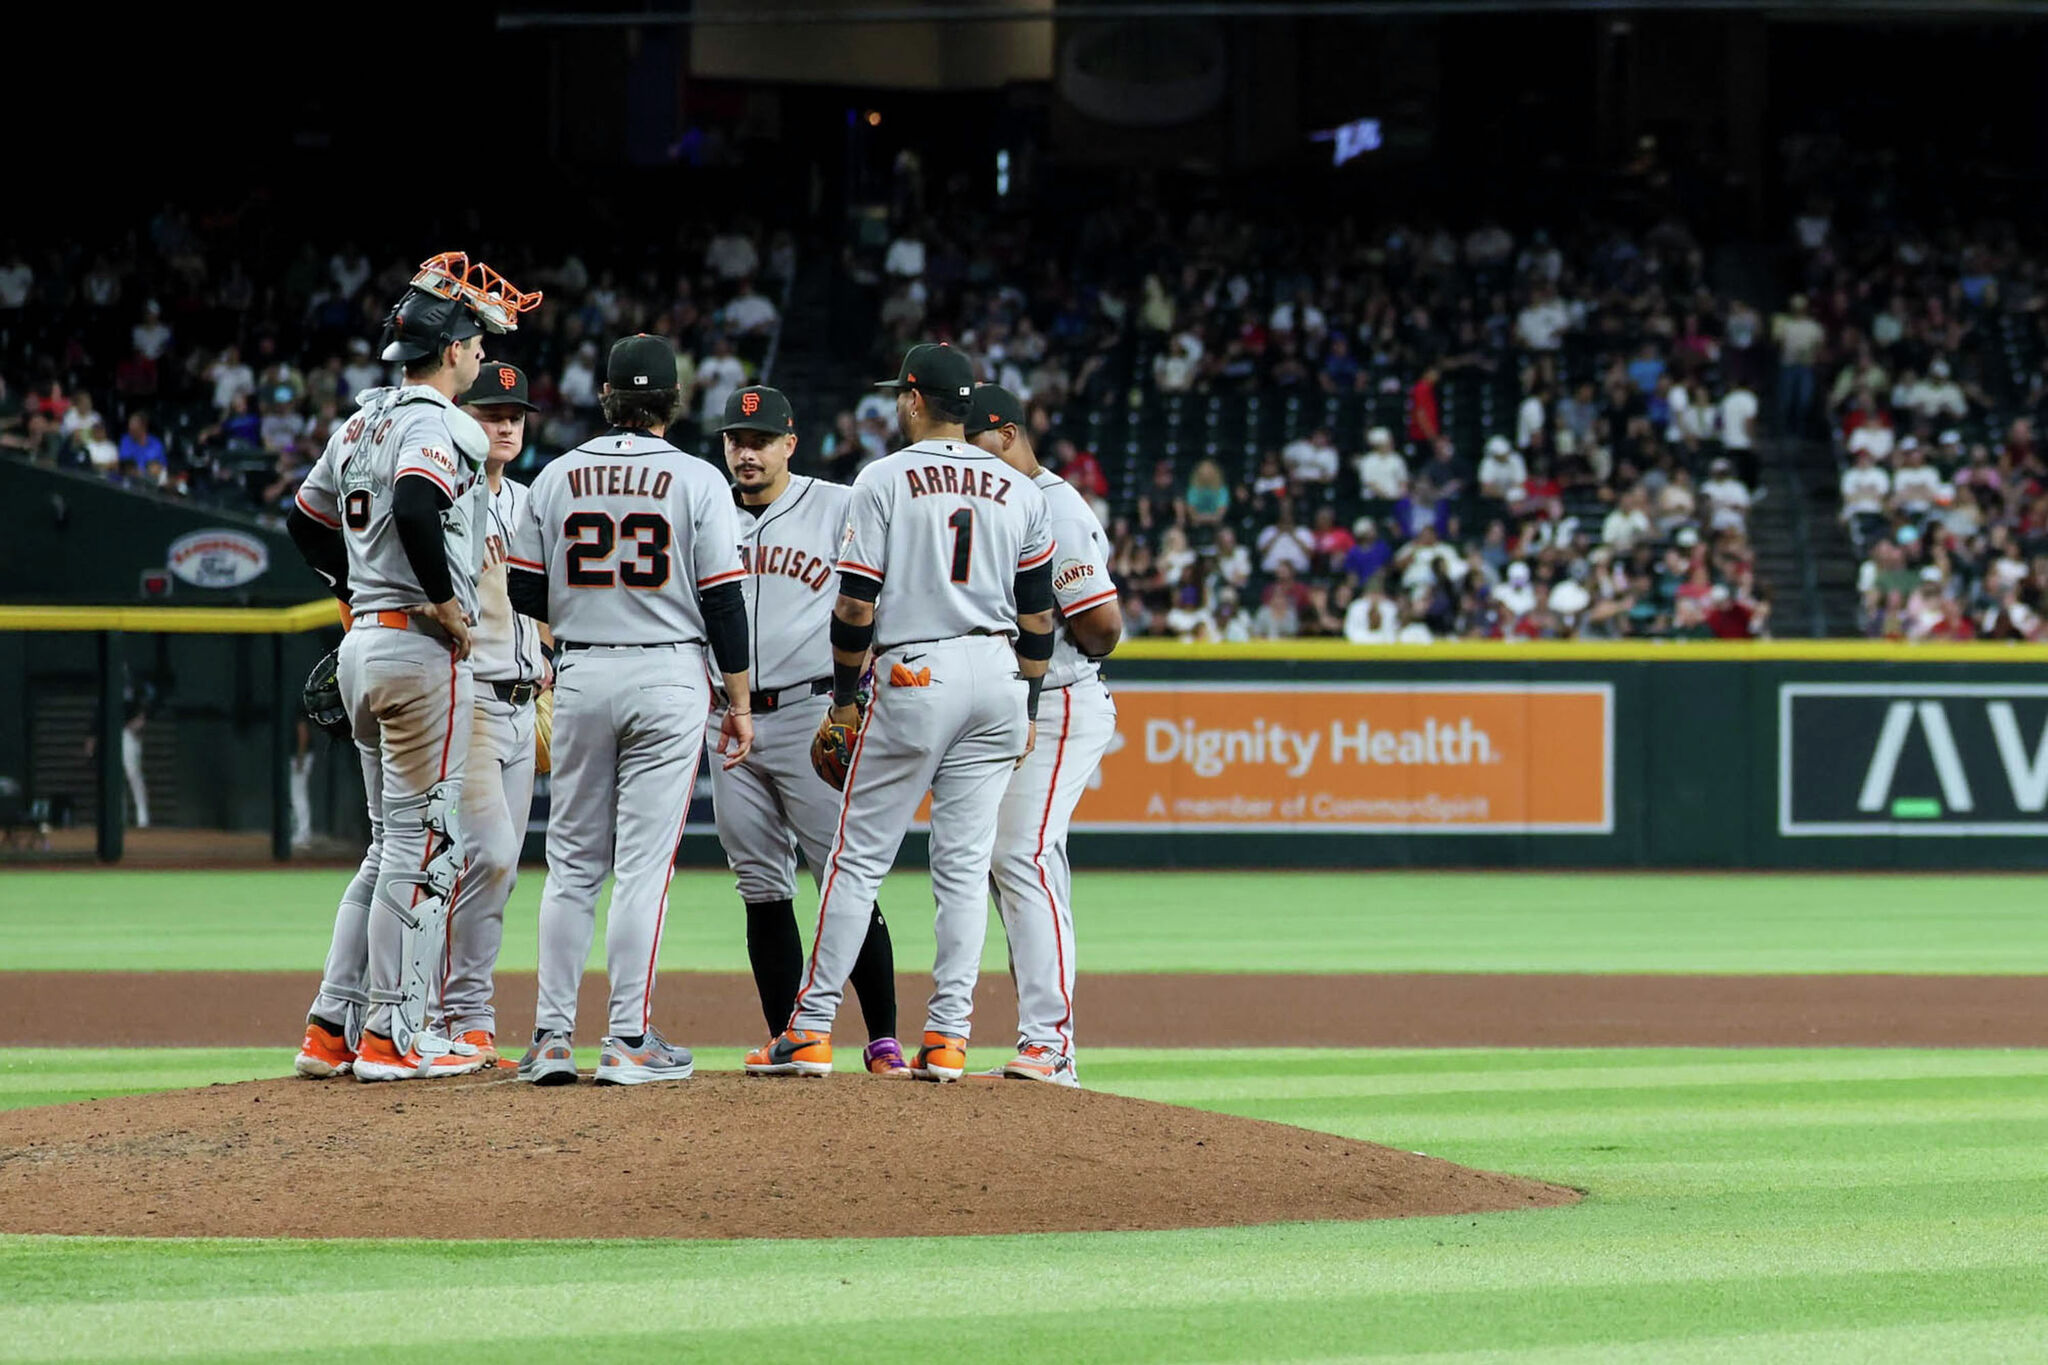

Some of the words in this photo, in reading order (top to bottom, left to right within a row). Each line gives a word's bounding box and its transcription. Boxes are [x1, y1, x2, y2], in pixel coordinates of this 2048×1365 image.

[499, 367, 517, 390] SF
[742, 392, 760, 416] SF
[567, 465, 673, 500] VITELLO
[905, 465, 1012, 506] ARRAEZ
[563, 511, 671, 590] 23
[948, 507, 973, 584] 1
[1053, 564, 1095, 591] GIANTS
[1145, 718, 1320, 778] Dignity
[1331, 717, 1491, 765] Health
[1147, 794, 1167, 816] A
